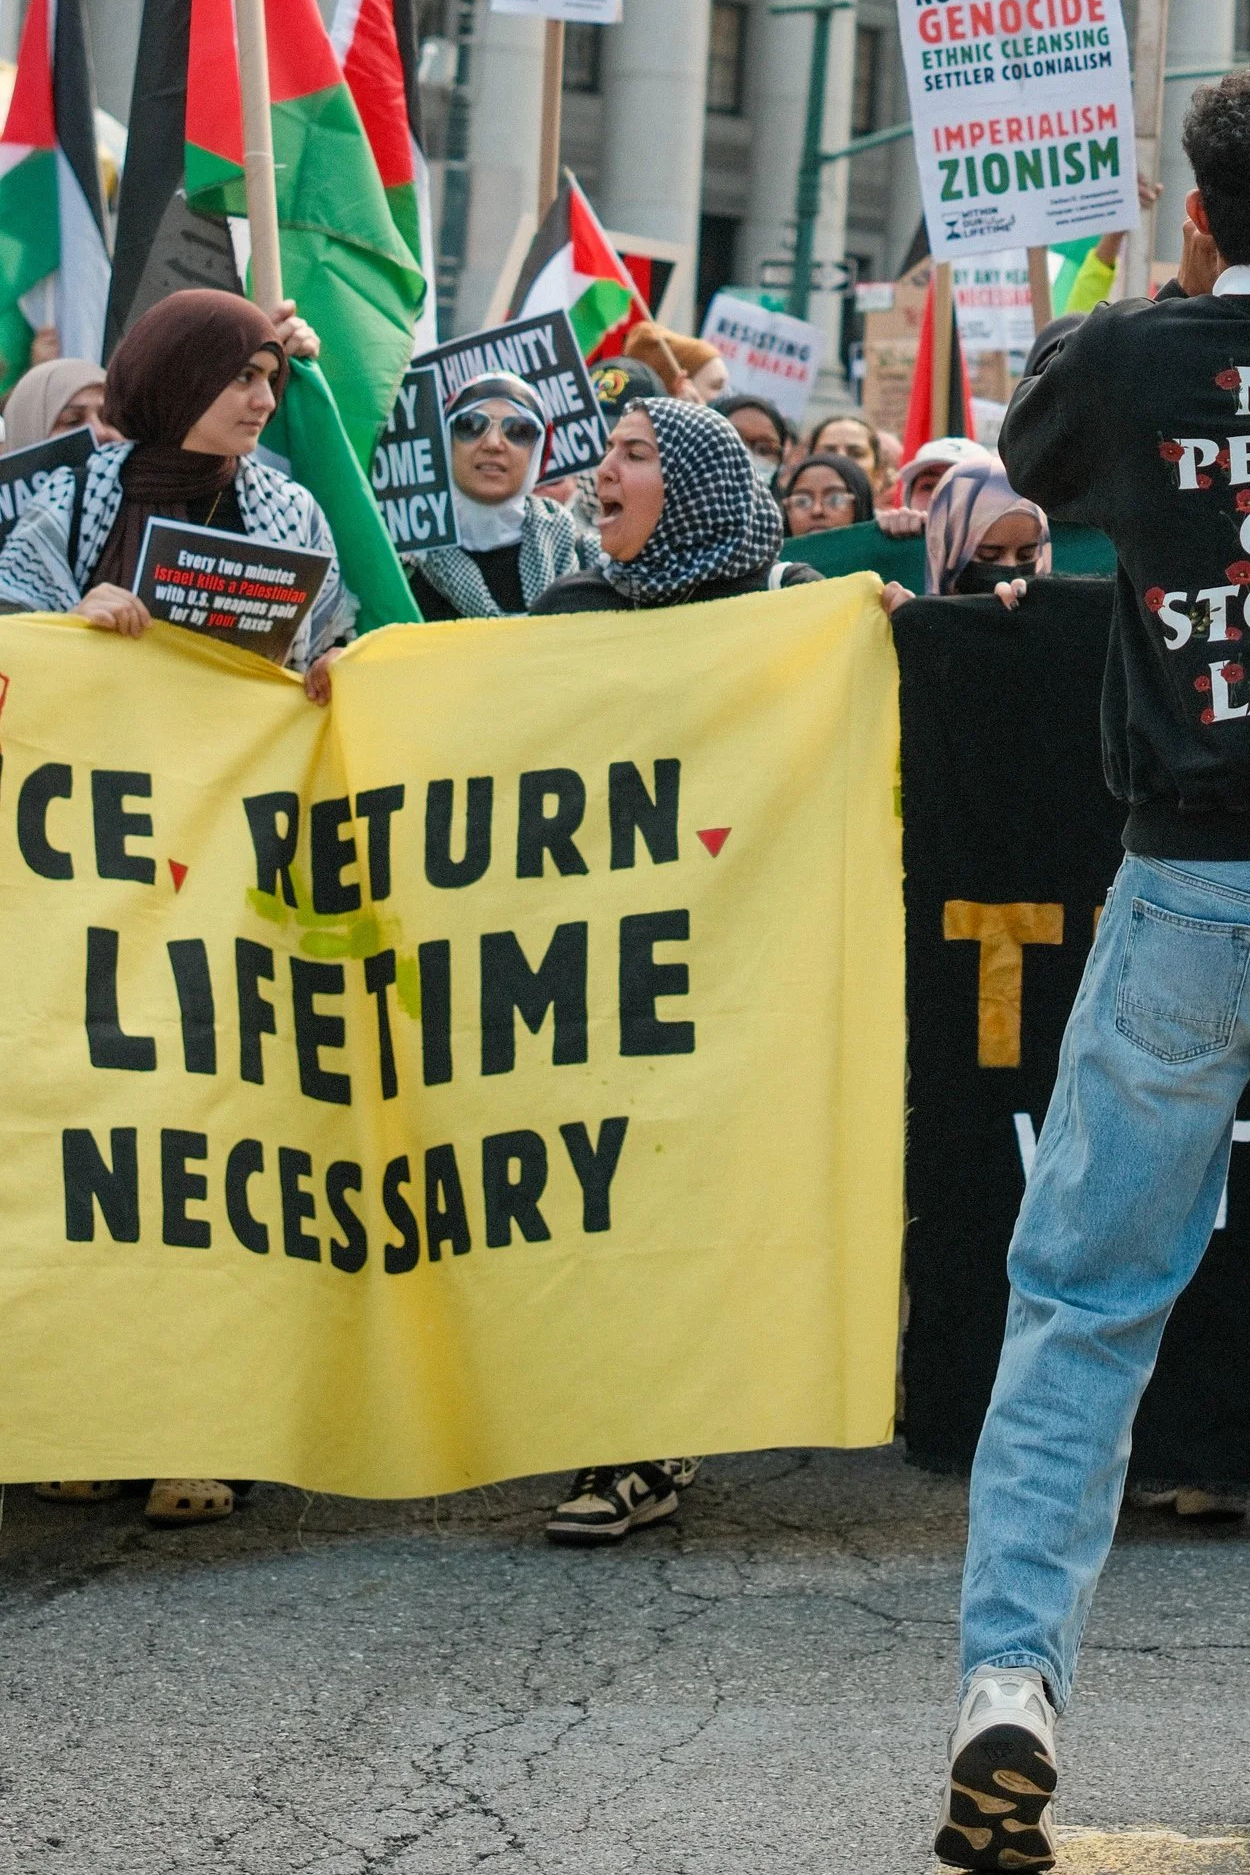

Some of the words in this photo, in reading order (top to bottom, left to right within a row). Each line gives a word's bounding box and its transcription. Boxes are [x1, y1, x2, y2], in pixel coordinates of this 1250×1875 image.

[922, 42, 994, 70] ETHNIC
[1001, 26, 1110, 61] CLEANSING
[924, 68, 996, 92] SETTLER
[1001, 51, 1113, 81] COLONIALISM
[933, 103, 1118, 153] IMPERIALISM
[939, 136, 1120, 203] ZIONISM
[442, 324, 559, 394] HUMANITY
[177, 549, 217, 573] Every
[218, 557, 243, 577] two
[244, 563, 297, 586] minutes
[196, 572, 226, 592] kills
[228, 581, 238, 594] a
[238, 581, 308, 604] Palestinian
[155, 584, 187, 604] with
[187, 589, 209, 608] U.S.
[213, 595, 269, 615] weapons
[268, 603, 298, 619] paid
[169, 605, 191, 622] for
[190, 607, 208, 626] by
[207, 612, 238, 628] your
[238, 616, 274, 633] taxes
[242, 757, 683, 915] RETURN
[85, 908, 697, 1107] LIFETIME
[62, 1116, 630, 1276] NECESSARY
